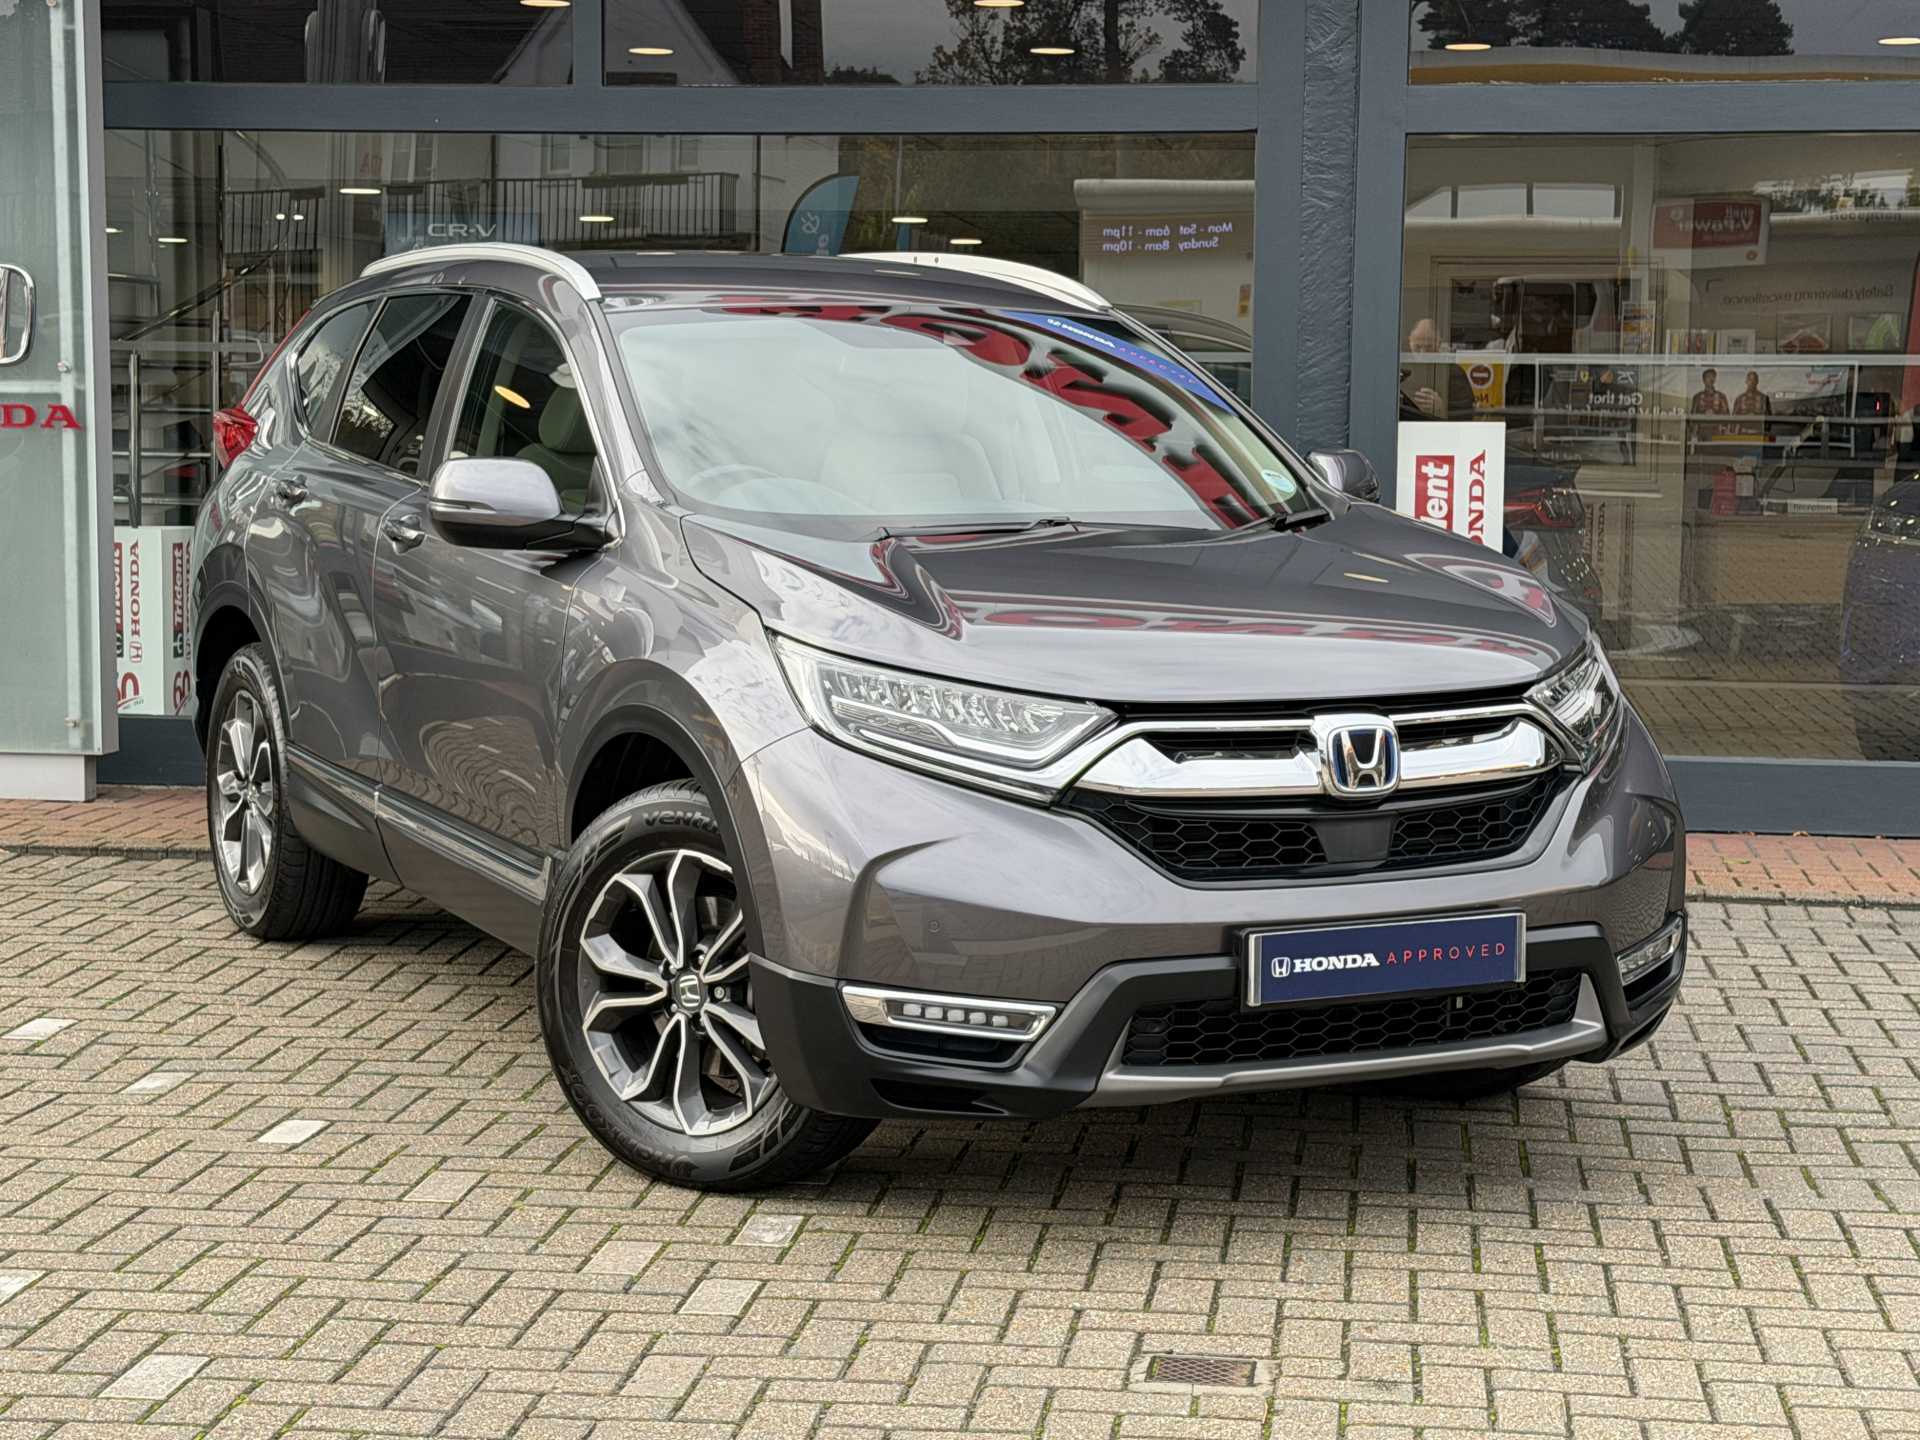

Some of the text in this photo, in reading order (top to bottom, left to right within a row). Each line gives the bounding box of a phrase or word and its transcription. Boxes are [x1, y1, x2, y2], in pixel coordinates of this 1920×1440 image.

[428, 223, 497, 237] CR-V
[130, 537, 141, 638] HONDA
[173, 545, 183, 627] Trident
[1293, 942, 1506, 974] HONDA APPROVED
